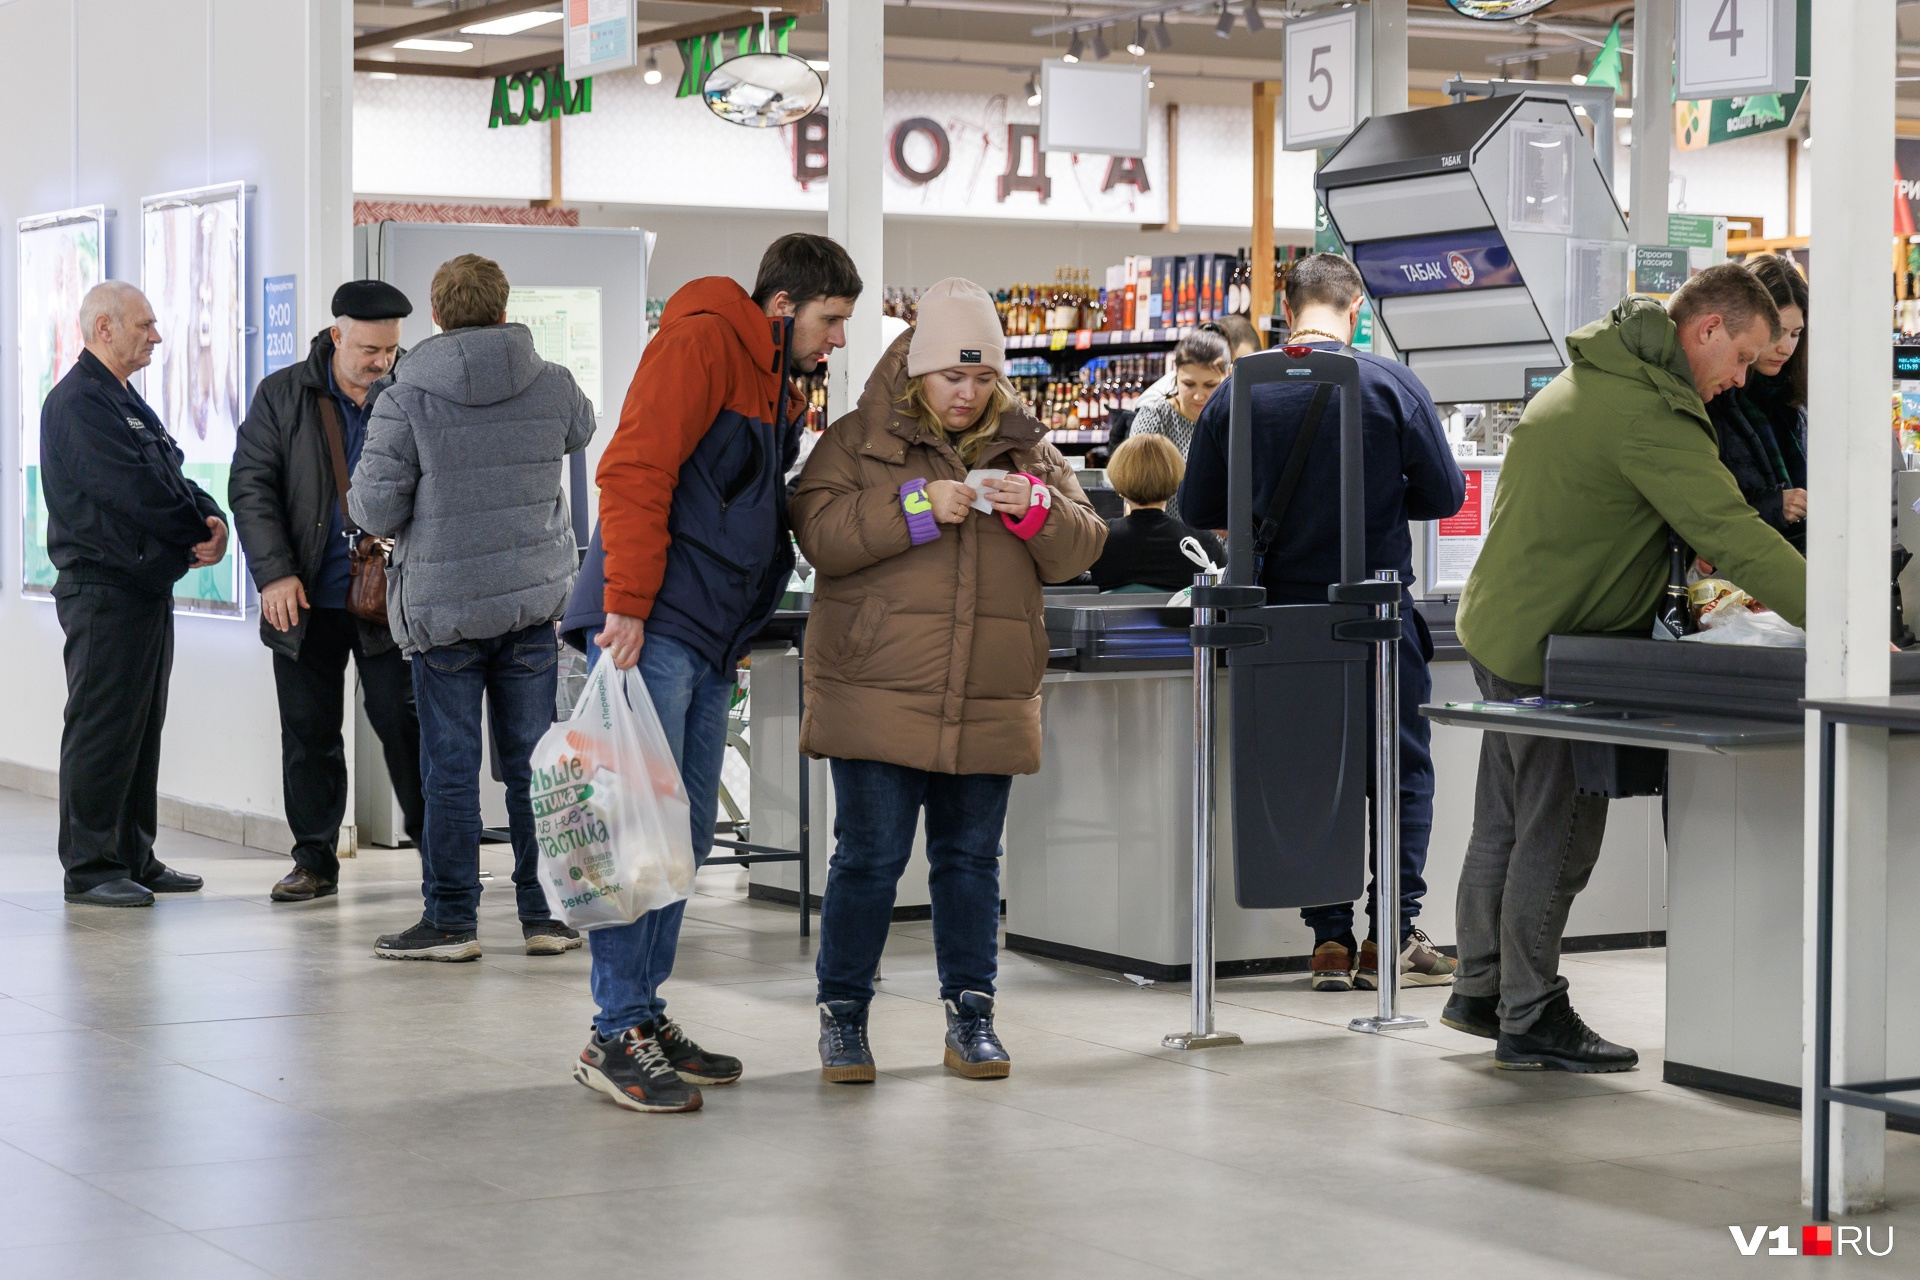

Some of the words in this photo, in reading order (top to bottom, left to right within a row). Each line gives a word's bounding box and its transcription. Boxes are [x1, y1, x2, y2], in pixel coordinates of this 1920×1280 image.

[1709, 0, 1743, 57] 4
[1308, 45, 1333, 112] 5
[1441, 154, 1462, 168] ТАБАК
[1637, 249, 1673, 260] Спросите
[1637, 259, 1643, 268] у
[1643, 259, 1673, 268] кассира
[1400, 261, 1447, 283] ТАБАК
[269, 302, 291, 327] 9:00
[266, 331, 294, 357] 23:00
[597, 670, 612, 720] Перекрёс
[538, 818, 611, 859] тастика
